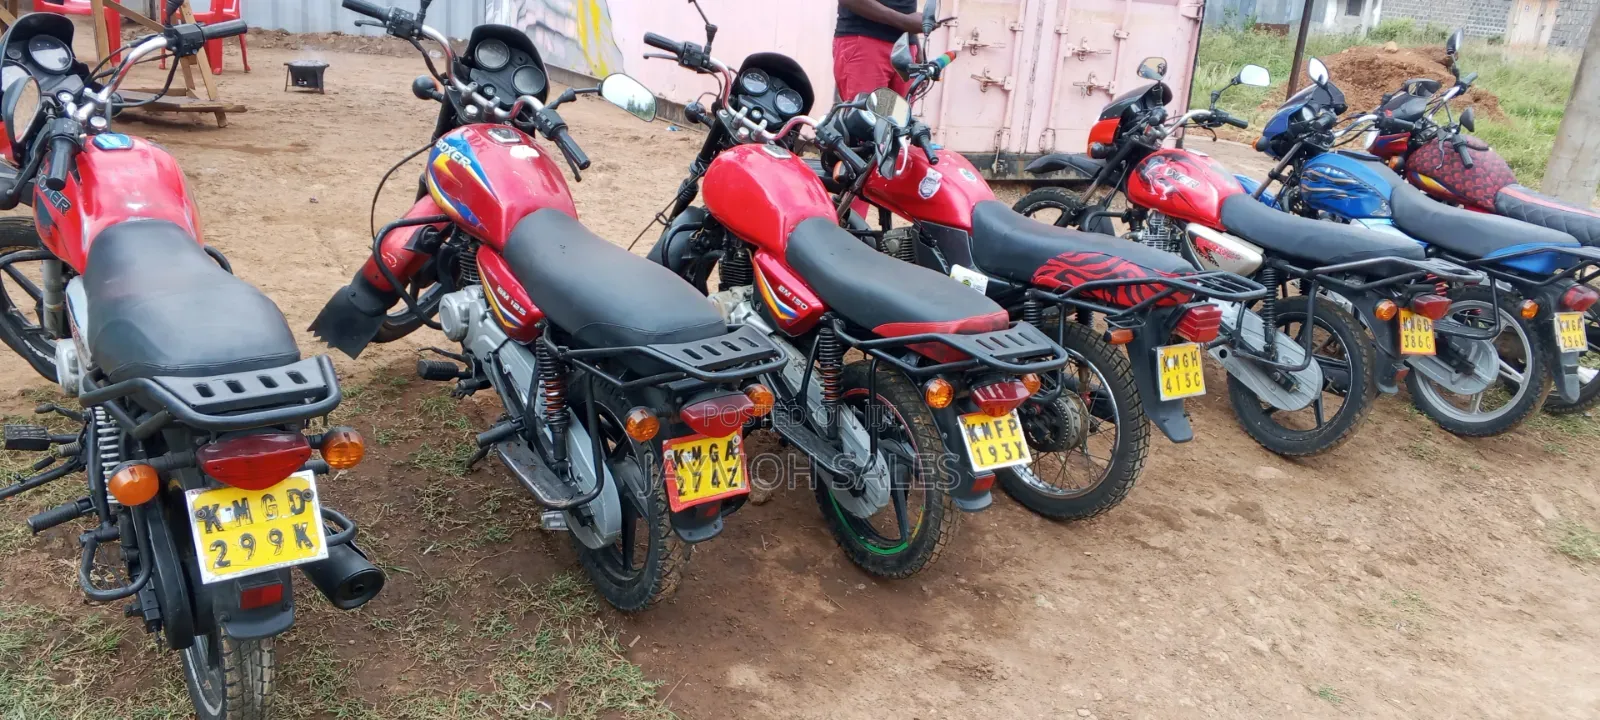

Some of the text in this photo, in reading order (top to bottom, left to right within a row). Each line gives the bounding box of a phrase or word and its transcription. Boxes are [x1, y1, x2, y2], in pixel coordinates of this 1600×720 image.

[435, 137, 472, 169] BOXER
[510, 299, 527, 316] 125
[791, 295, 809, 310] 150
[1403, 316, 1431, 333] KMGD
[1163, 350, 1199, 373] KMGH
[1165, 372, 1201, 393] 415C
[966, 418, 1018, 444] KMFP
[672, 440, 738, 471] KMGA
[975, 441, 1026, 466] 193X
[677, 466, 739, 497] 274Z
[201, 487, 307, 535] KMGD
[209, 521, 314, 569] 299K
